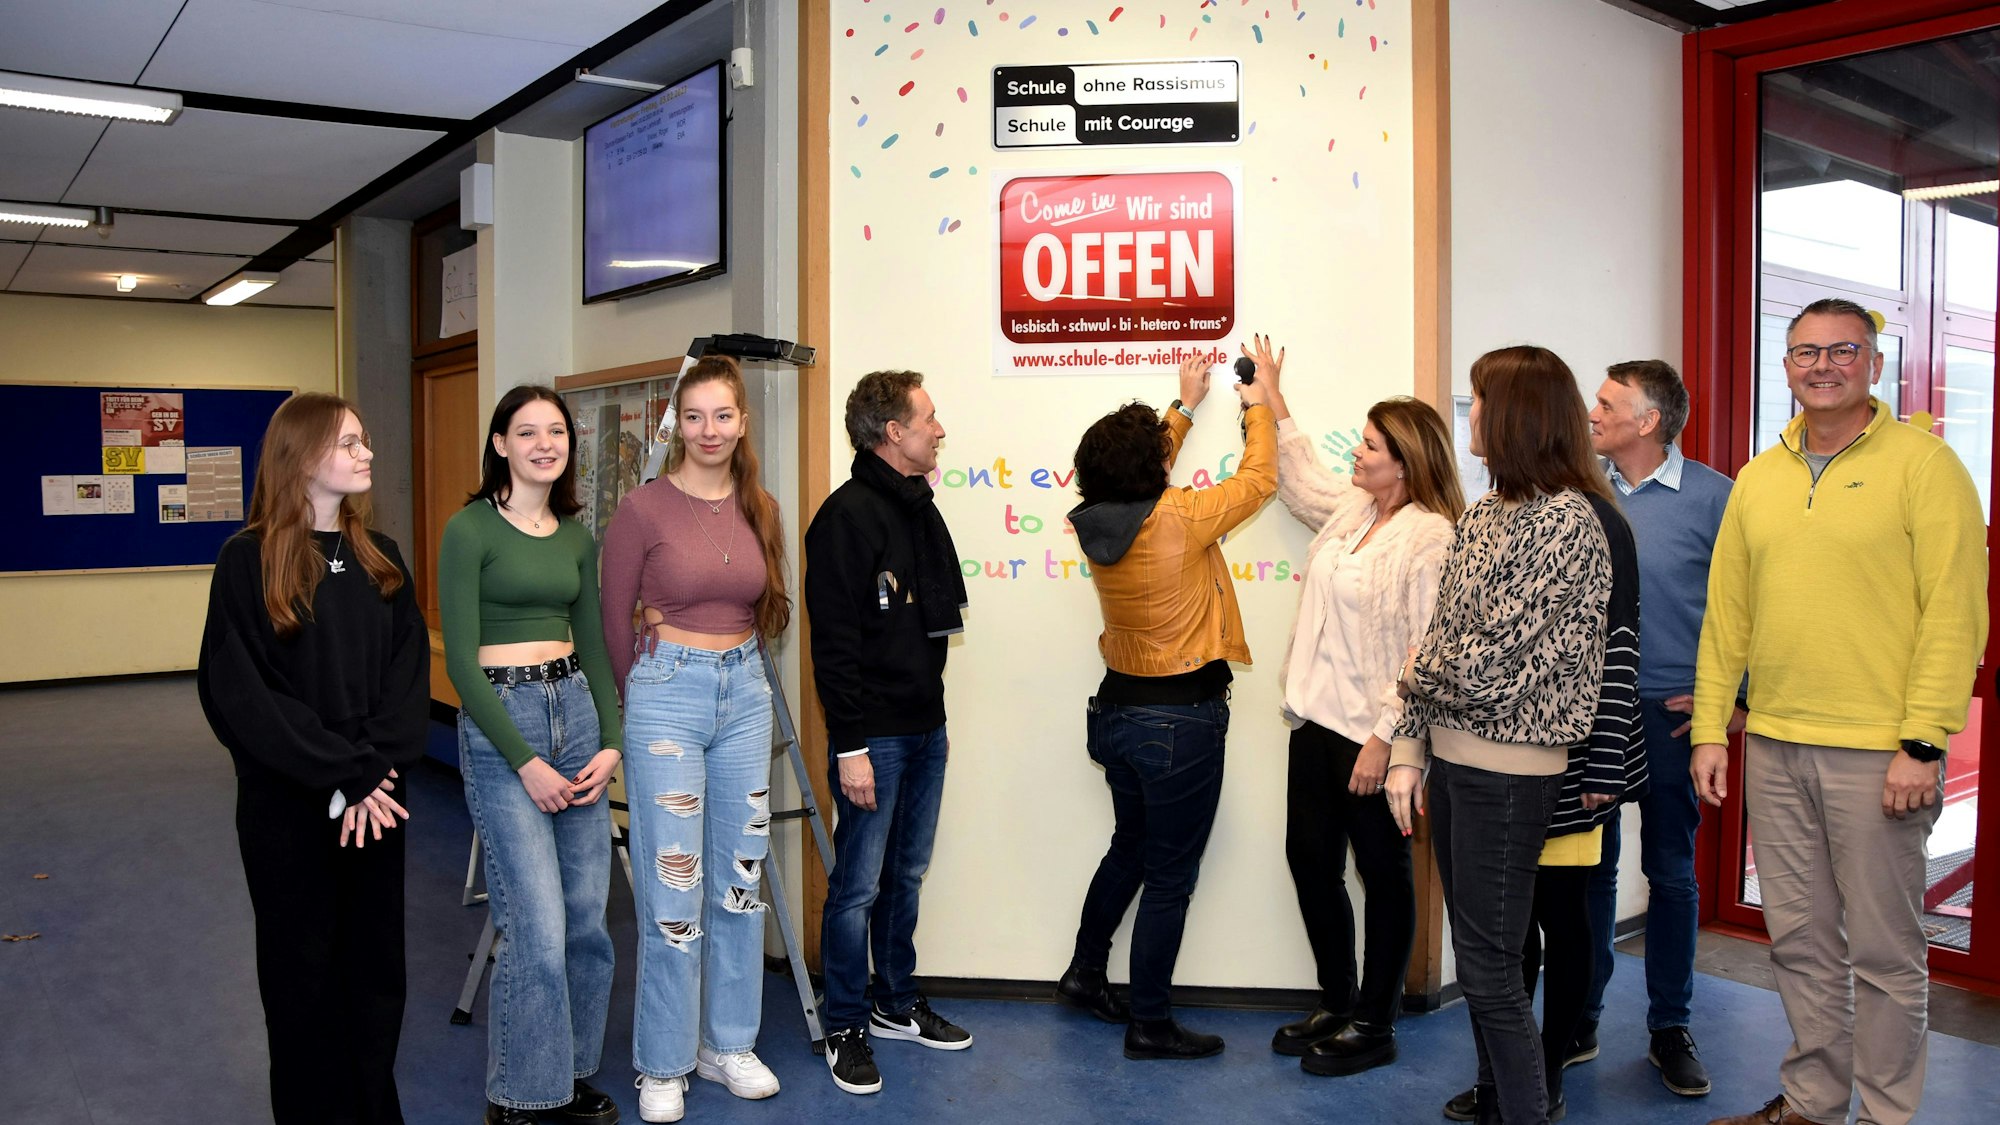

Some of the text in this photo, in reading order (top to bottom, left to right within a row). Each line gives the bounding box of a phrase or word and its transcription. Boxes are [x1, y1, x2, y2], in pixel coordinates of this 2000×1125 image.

[1007, 76, 1226, 95] Schule ohne Rassismus
[1007, 115, 1195, 133] Schule mit Courage
[1020, 191, 1213, 224] Come in Wir sind
[1022, 229, 1215, 302] OFFEN
[1011, 319, 1060, 334] lesbisch
[1068, 317, 1111, 333] schwul
[1119, 317, 1132, 331] bi
[1140, 316, 1181, 331] hetero
[153, 418, 178, 431] SV
[106, 447, 142, 467] SV
[1004, 504, 1044, 535] to
[960, 549, 1301, 582] our tru urs.
